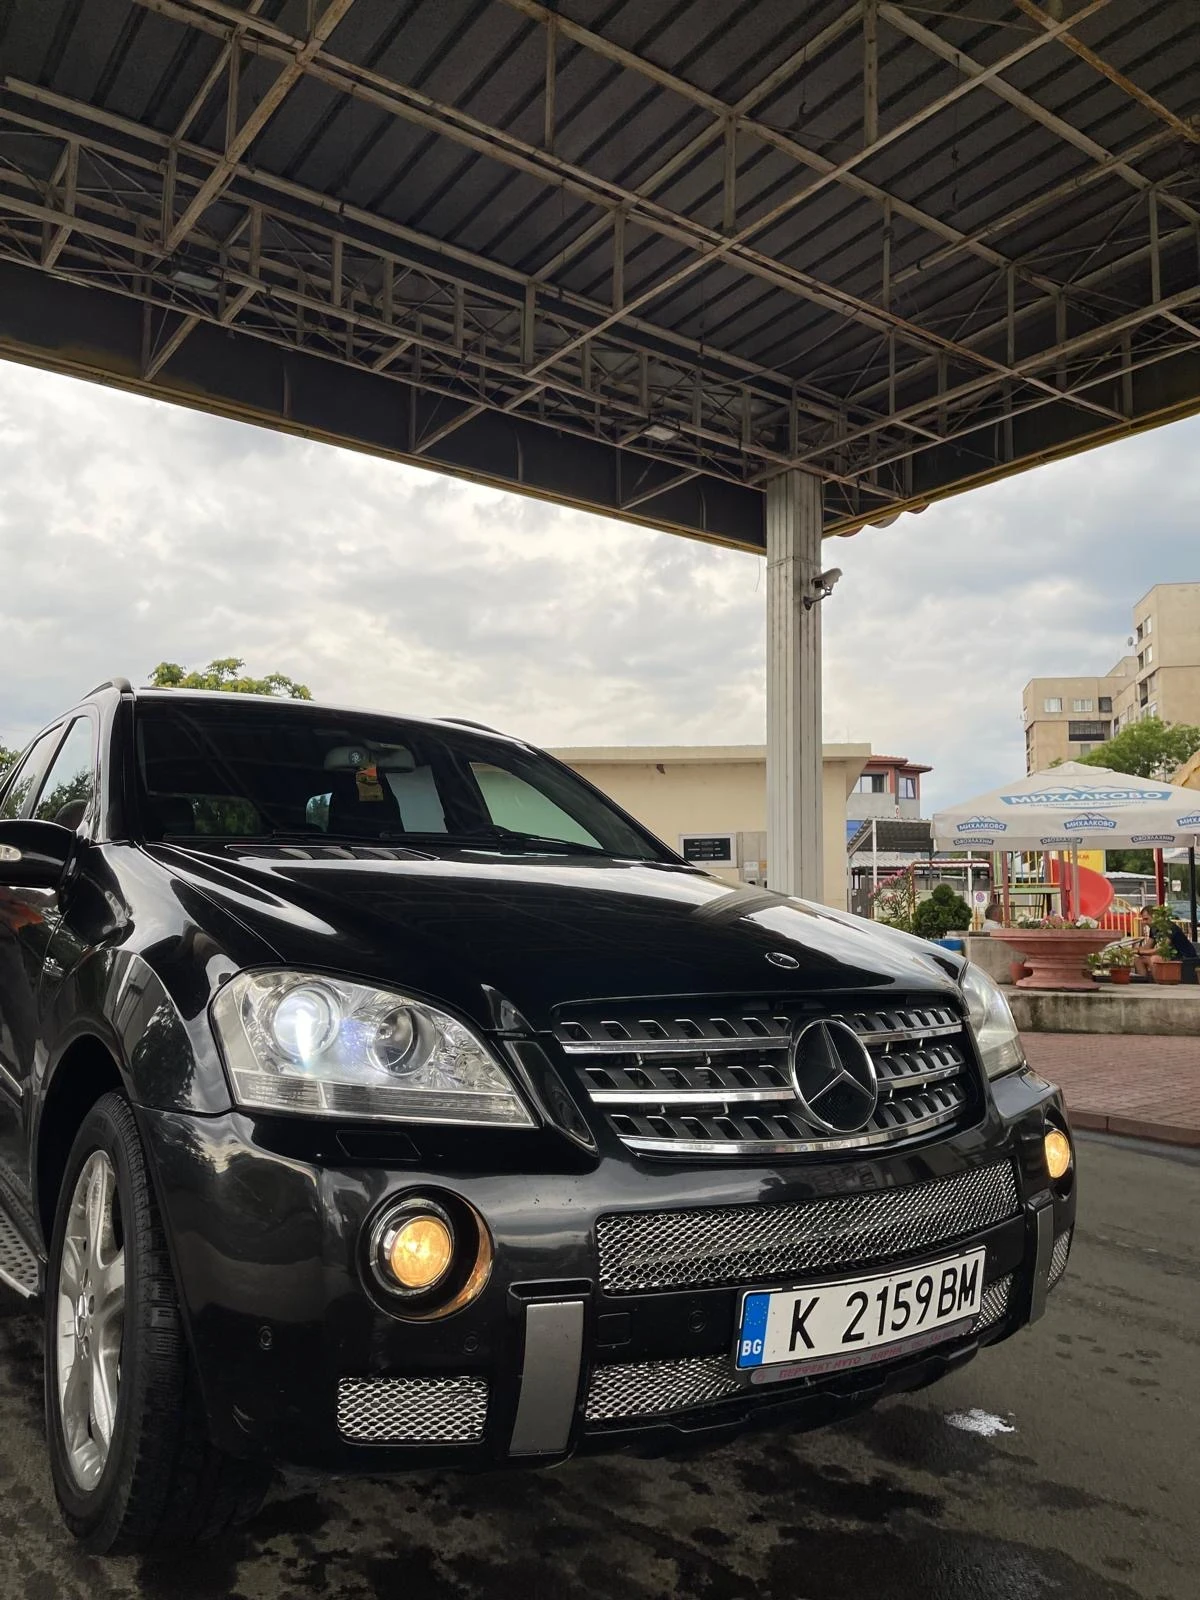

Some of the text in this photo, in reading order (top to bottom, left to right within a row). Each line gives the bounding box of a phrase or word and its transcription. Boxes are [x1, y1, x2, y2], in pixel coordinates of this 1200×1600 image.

[1010, 792, 1163, 804] МИХАЛКОВО
[959, 822, 1006, 831] МИХАЛКОВО
[1066, 819, 1115, 829] МИХАЛКОВО
[788, 1297, 820, 1352] K
[742, 1340, 762, 1356] BG
